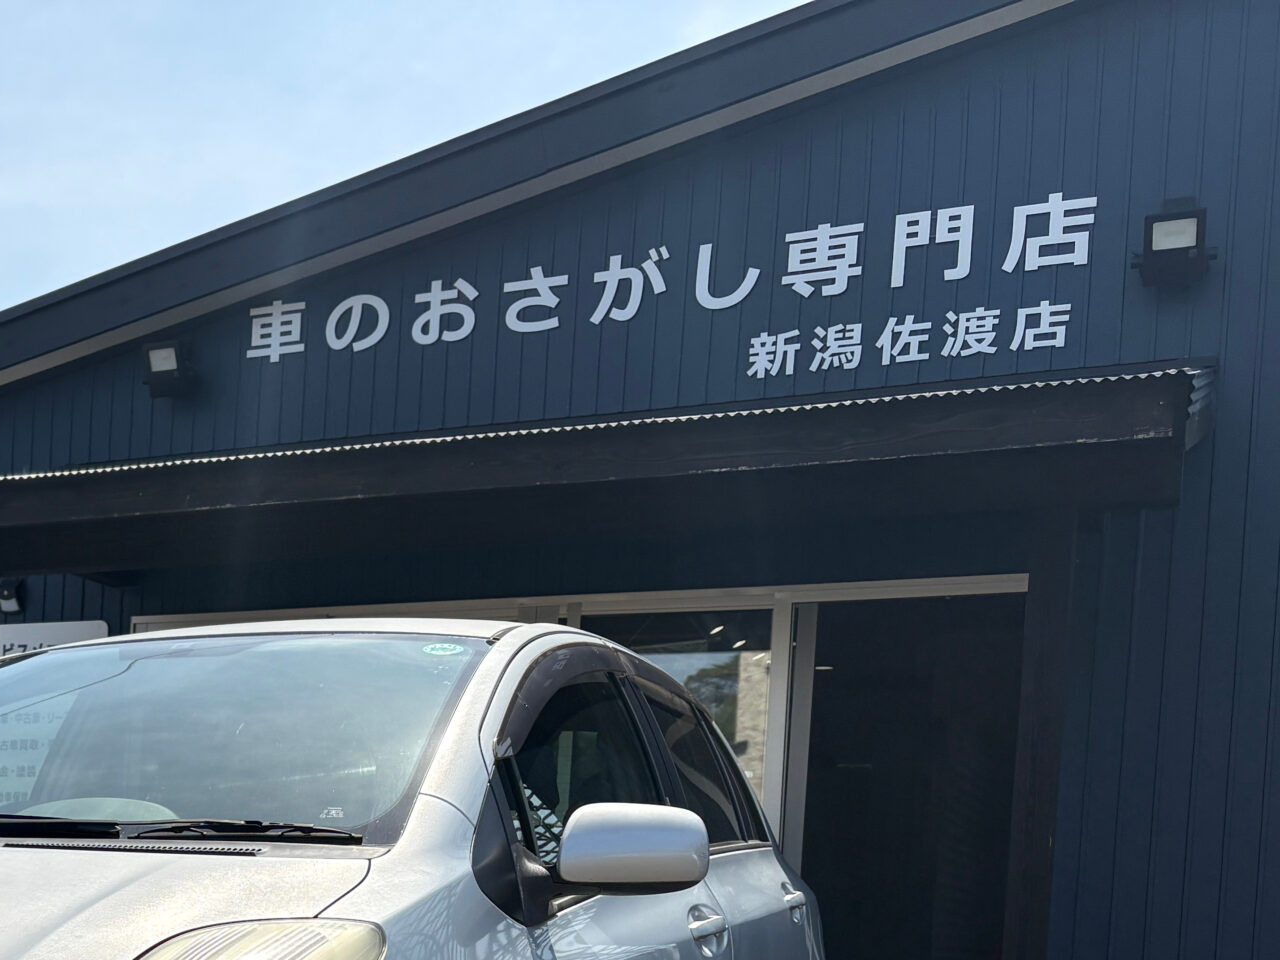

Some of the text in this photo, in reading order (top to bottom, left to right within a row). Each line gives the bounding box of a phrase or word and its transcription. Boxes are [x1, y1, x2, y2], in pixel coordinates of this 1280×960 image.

[246, 192, 1097, 363] 車のおさがし専門店
[748, 302, 1071, 379] 新潟佐渡店
